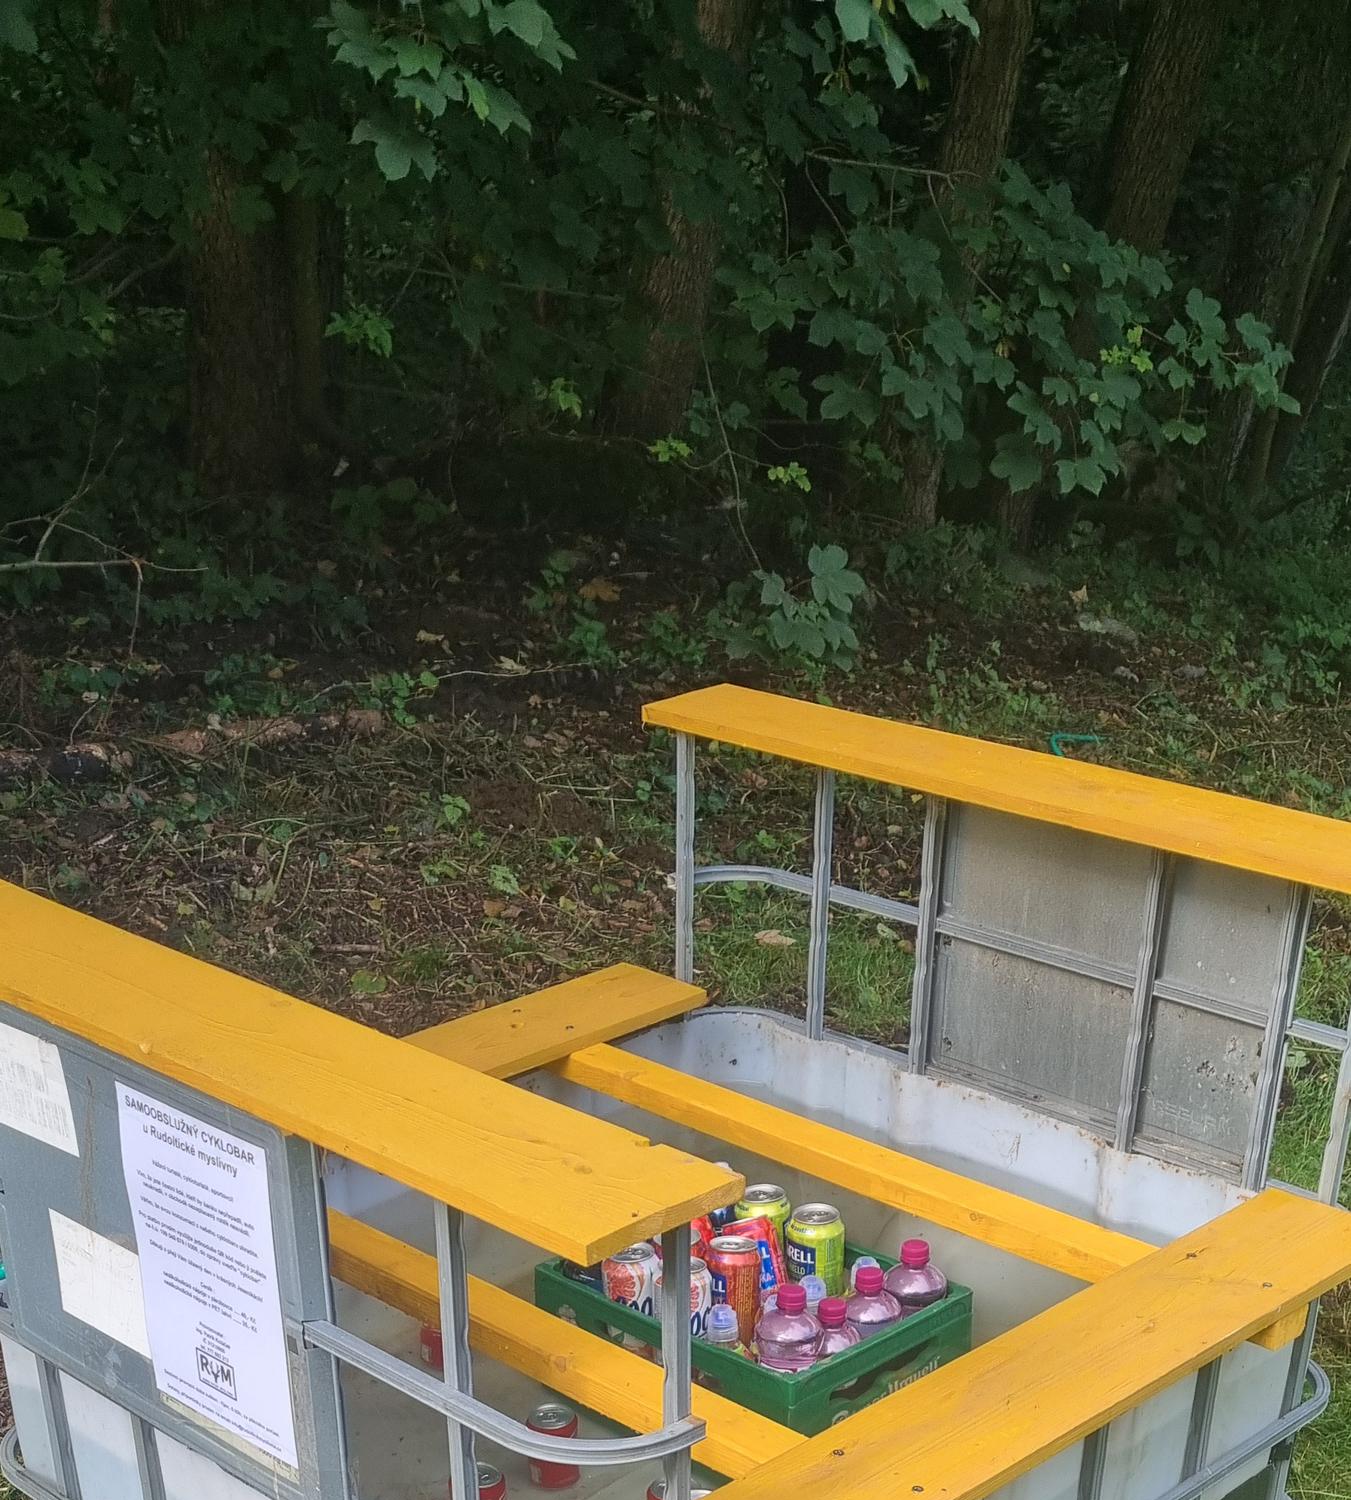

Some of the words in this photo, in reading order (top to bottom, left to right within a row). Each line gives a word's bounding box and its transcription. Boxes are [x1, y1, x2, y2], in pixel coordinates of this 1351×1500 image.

[125, 1095, 198, 1139] SAMOOBSLUŽNÝ
[201, 1131, 255, 1165] CYKLOBAR
[143, 1124, 149, 1134] u
[197, 1150, 238, 1178] myslivny
